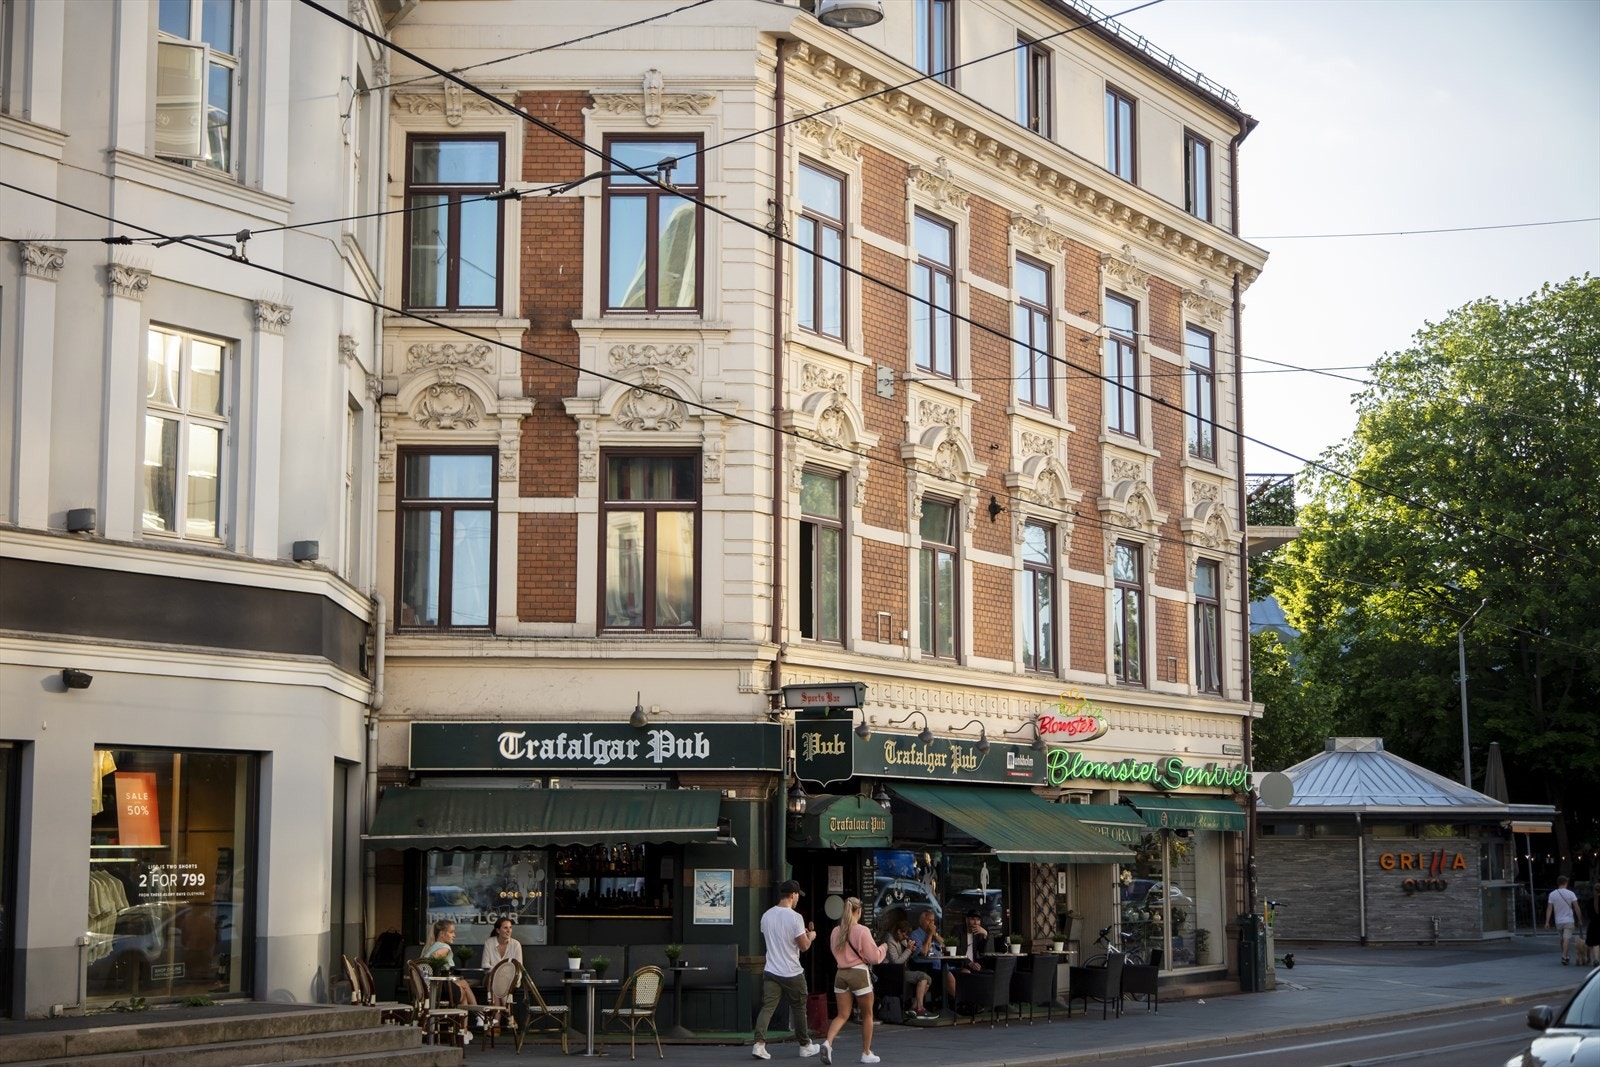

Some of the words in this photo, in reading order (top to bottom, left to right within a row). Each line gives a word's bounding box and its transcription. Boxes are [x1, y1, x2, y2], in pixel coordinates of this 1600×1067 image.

[801, 692, 825, 704] Sports
[826, 692, 840, 704] Bar
[1038, 715, 1097, 736] Blomster
[497, 731, 640, 765] Trafalgar
[646, 730, 710, 764] Pub
[802, 732, 846, 762] Pub
[884, 740, 948, 774] Trafalgar
[950, 744, 977, 774] Pub
[1047, 750, 1162, 785] Blomster
[1160, 757, 1253, 792] Sentret
[126, 792, 148, 800] SALE
[127, 806, 149, 815] 50%
[830, 816, 869, 832] Trafalgar
[871, 816, 886, 833] Pub
[139, 874, 147, 887] 2
[152, 874, 178, 886] FOR
[182, 873, 205, 886] 799
